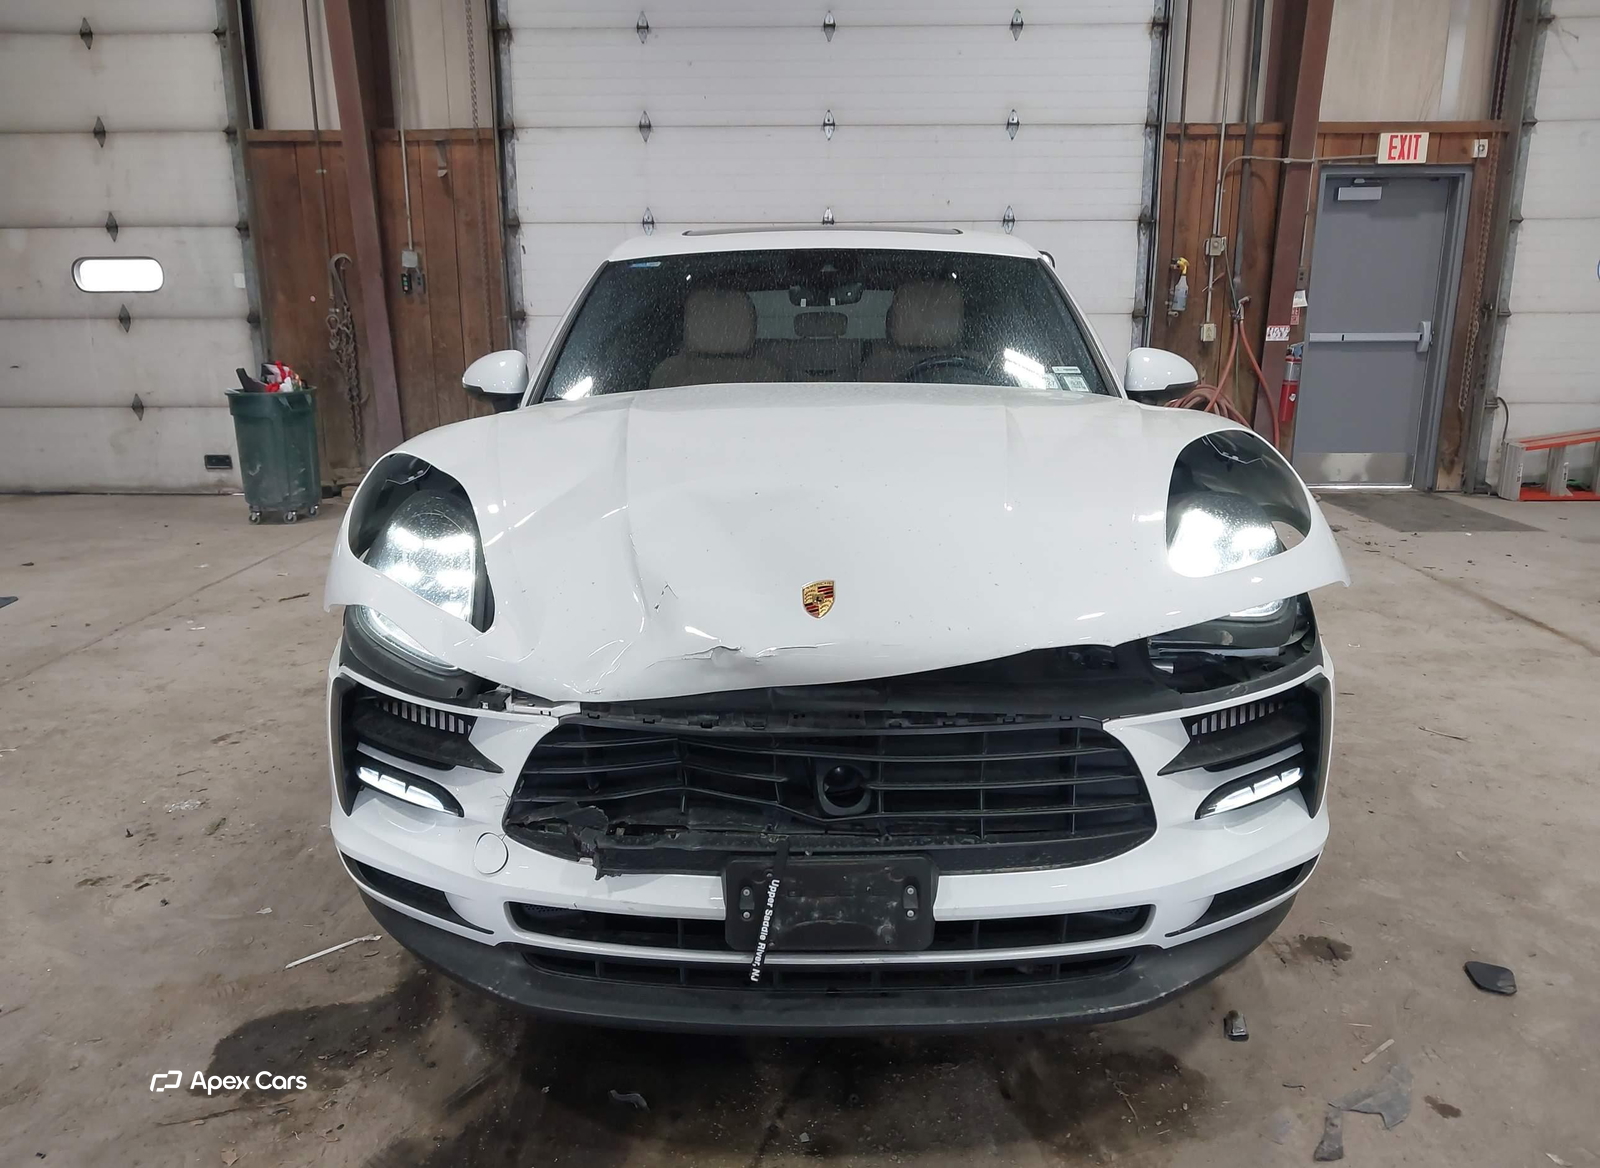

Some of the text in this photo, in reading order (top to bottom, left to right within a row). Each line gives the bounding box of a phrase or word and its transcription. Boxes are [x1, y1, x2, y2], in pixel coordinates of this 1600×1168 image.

[1387, 134, 1422, 160] EXIT
[750, 879, 780, 982] Upper Saddle River, NJ
